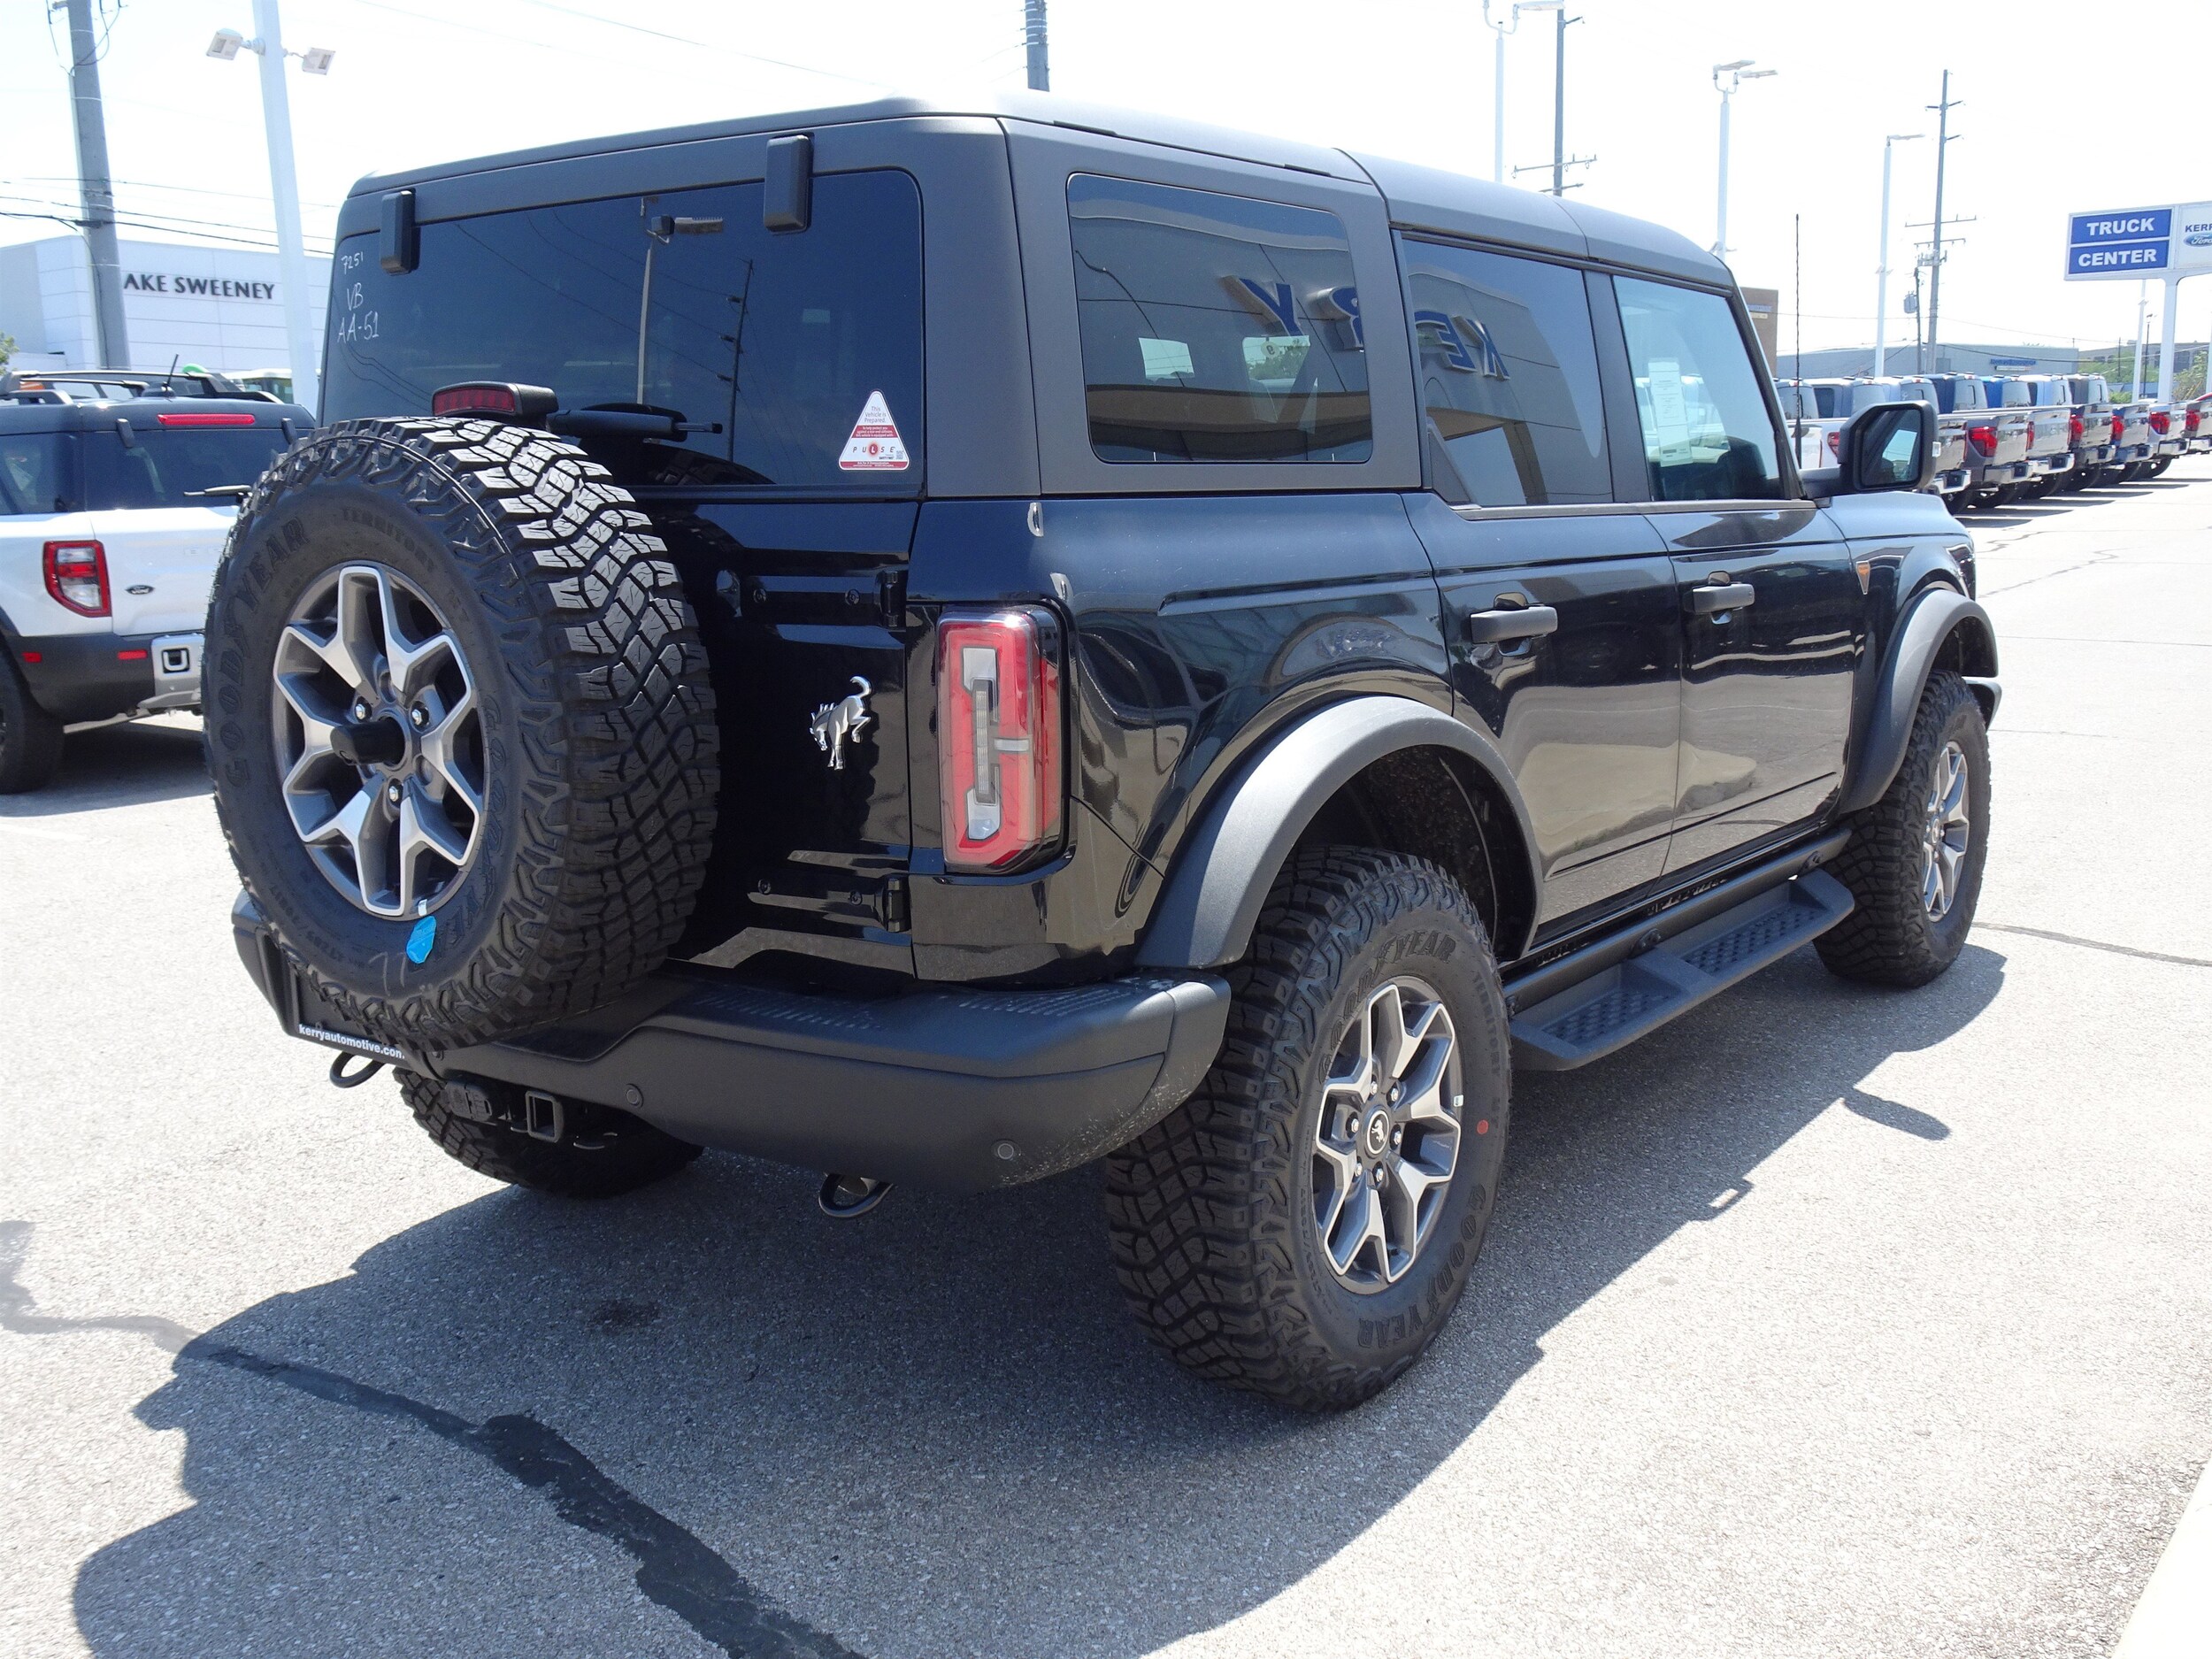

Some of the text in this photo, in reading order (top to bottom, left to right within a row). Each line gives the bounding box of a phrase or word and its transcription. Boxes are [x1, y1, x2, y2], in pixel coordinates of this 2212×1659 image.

[2086, 217, 2155, 236] TRUCK
[341, 251, 364, 275] 7251
[2078, 248, 2157, 267] CENTER
[123, 273, 276, 300] AKE SWEENEY
[346, 282, 364, 311] VB
[336, 310, 380, 344] AA-51
[218, 511, 311, 790] GOODYEAR
[1357, 1181, 1487, 1350] GOODYEAR
